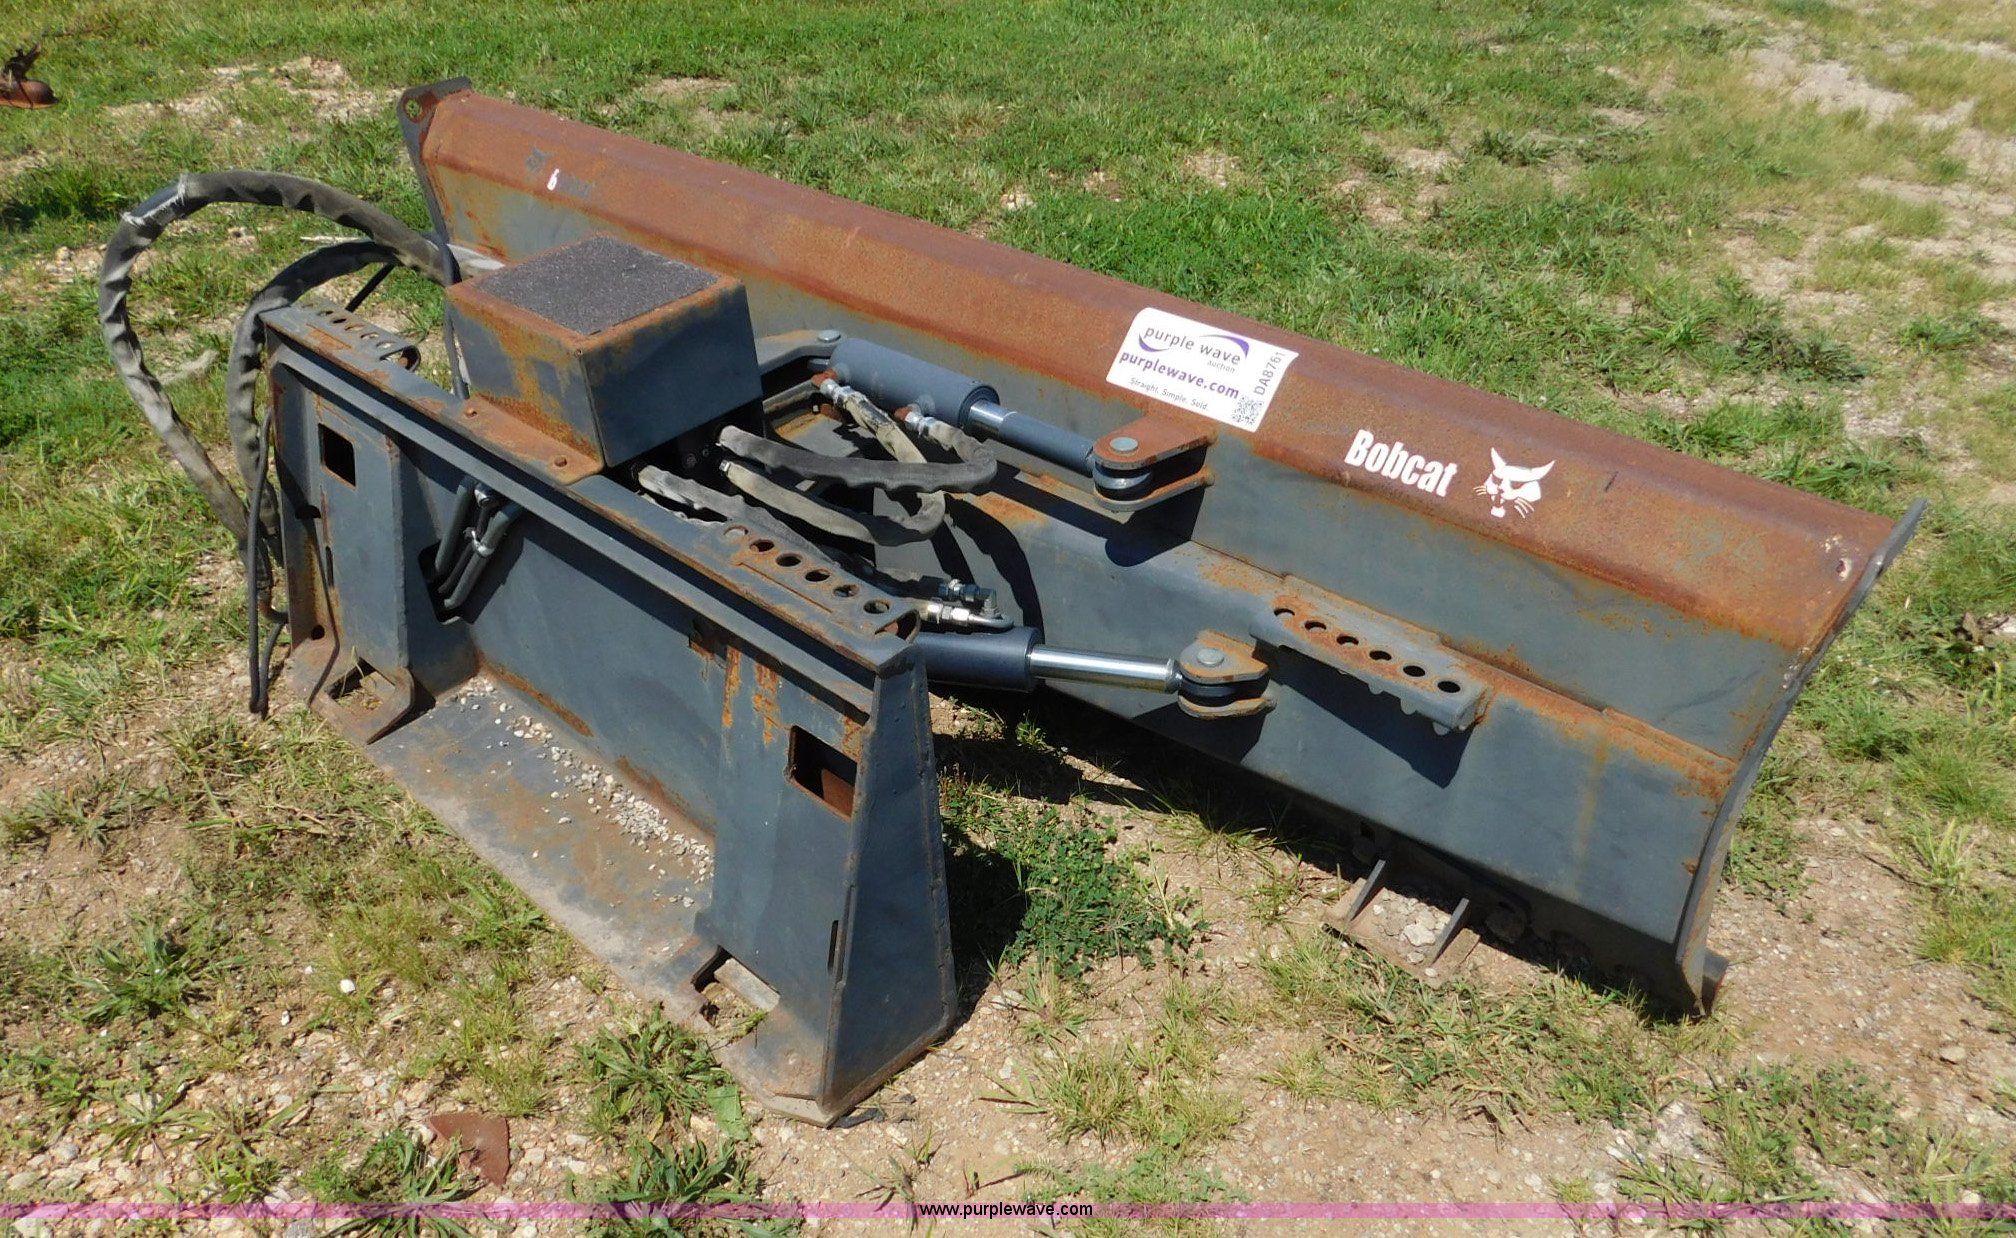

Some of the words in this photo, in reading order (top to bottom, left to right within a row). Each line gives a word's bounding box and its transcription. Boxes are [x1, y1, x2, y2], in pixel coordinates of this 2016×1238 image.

[1144, 327, 1195, 350] purple
[1200, 344, 1241, 365] wave
[1119, 351, 1239, 399] purplewave.com
[1207, 361, 1236, 373] auction
[1254, 352, 1285, 396] DA8761
[1129, 377, 1159, 394] Straight.
[1161, 388, 1188, 404] Simple.
[1190, 398, 1209, 411] Sold.
[1344, 429, 1458, 498] Bobcat
